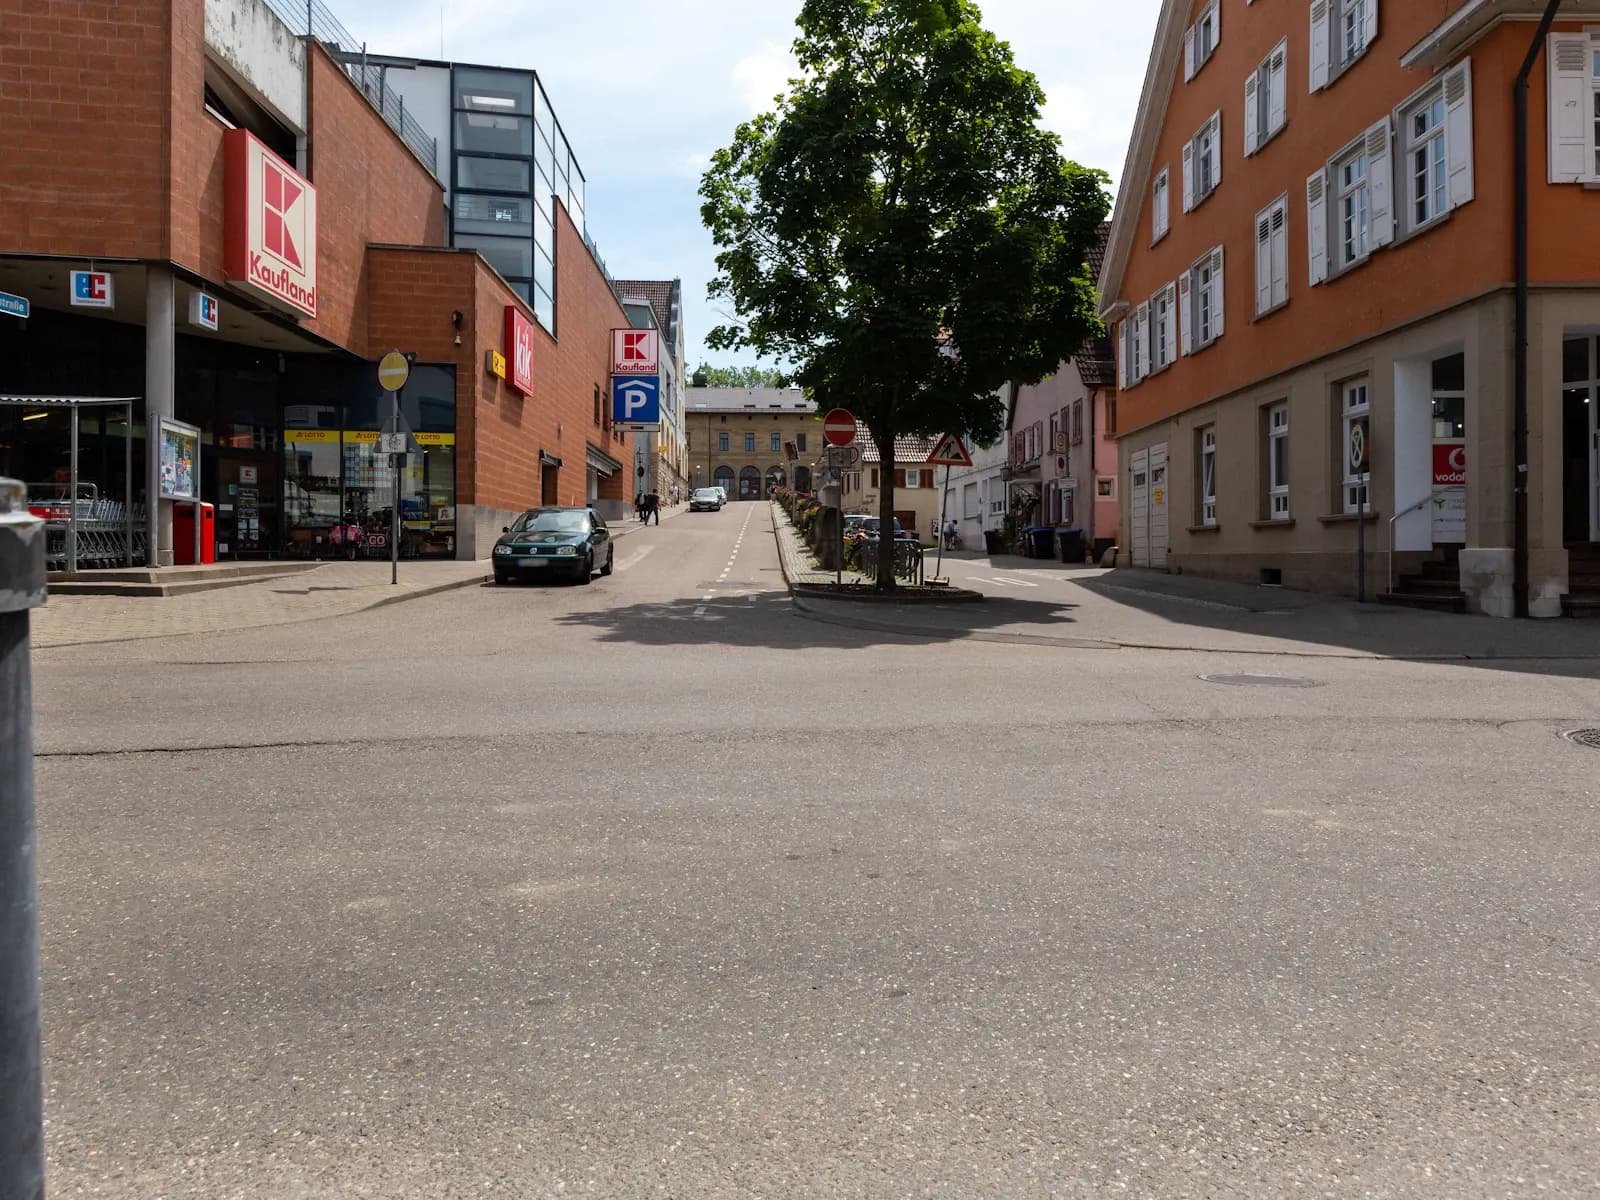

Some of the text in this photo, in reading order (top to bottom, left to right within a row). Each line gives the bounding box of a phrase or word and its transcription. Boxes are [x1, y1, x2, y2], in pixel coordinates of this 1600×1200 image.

[250, 251, 315, 308] Kaufland
[615, 362, 656, 371] Kaufland
[625, 390, 647, 418] P
